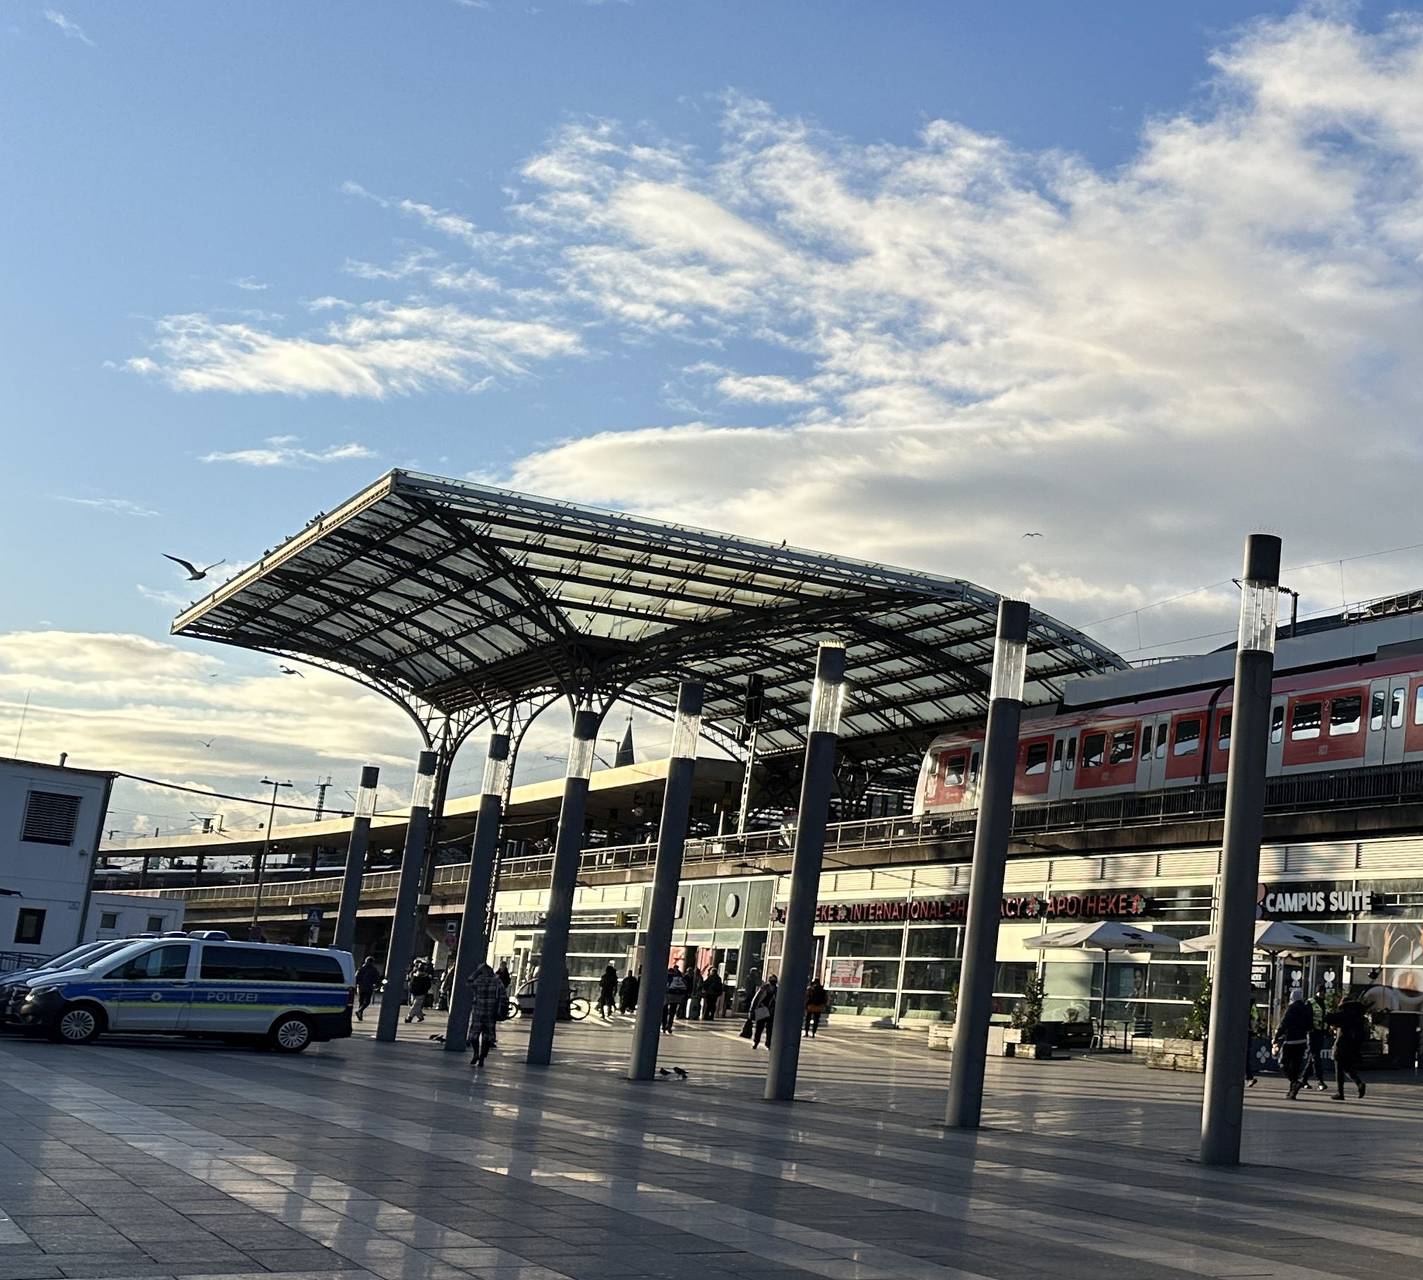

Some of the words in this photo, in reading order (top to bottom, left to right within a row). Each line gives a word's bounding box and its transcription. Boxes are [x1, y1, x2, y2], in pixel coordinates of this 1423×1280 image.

[850, 902, 944, 921] INTERNATIONAL
[1047, 894, 1127, 916] APOTHEKE
[1265, 891, 1325, 913] CAMPUS
[1329, 890, 1372, 912] SUITE
[206, 992, 259, 1003] POLIZEI
